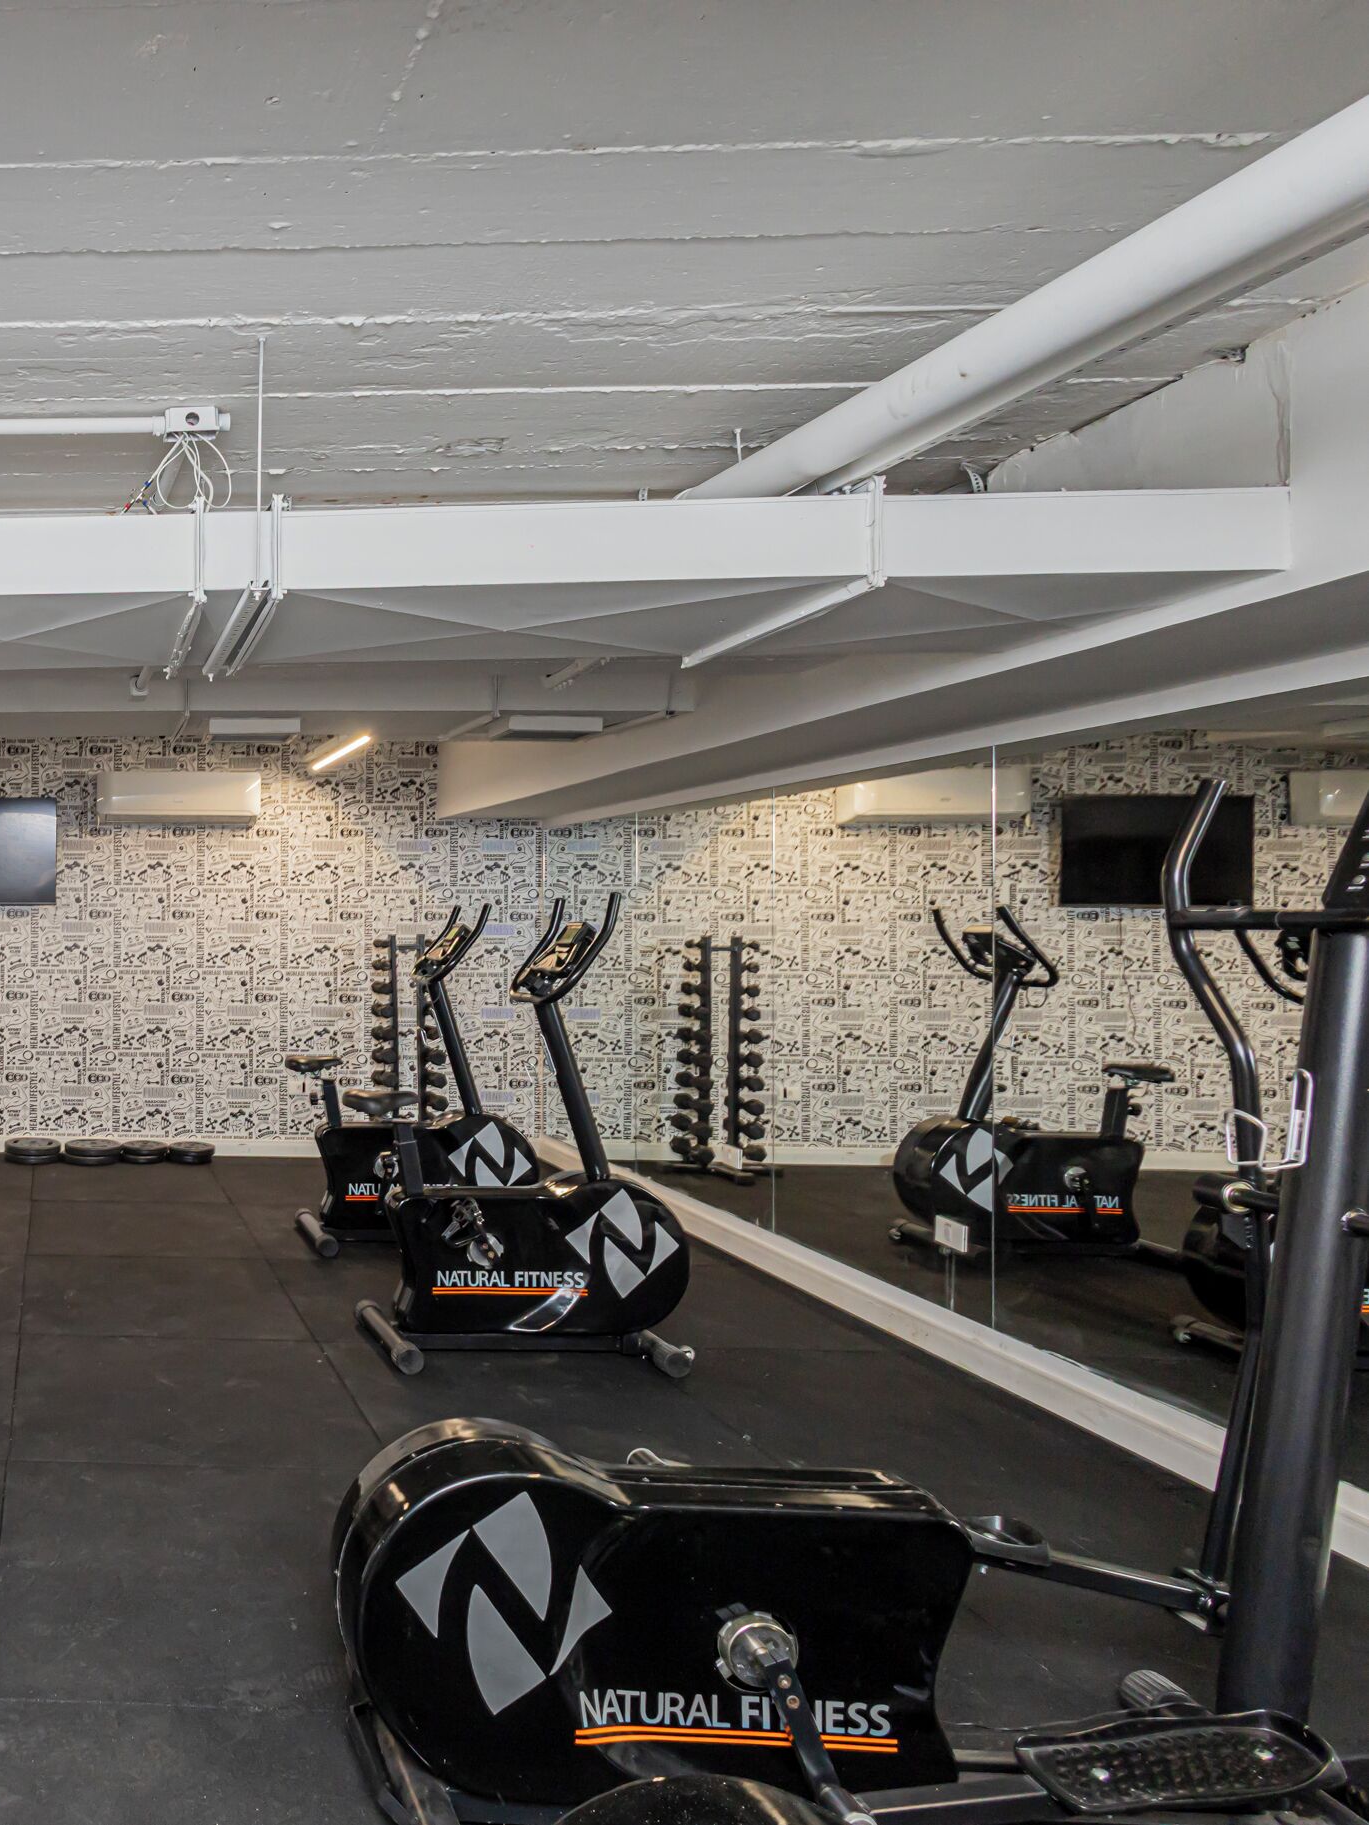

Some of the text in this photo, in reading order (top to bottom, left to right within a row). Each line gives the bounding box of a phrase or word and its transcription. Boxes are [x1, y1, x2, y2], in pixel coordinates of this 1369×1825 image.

[364, 744, 373, 803] HEALTHY LIFESTYLE
[113, 826, 122, 885] HEALTHY LIFESTYLE
[364, 827, 373, 886] HEALTHY LIFESTYLE
[449, 827, 458, 886] HEALTHY LIFESTYLE
[30, 908, 39, 967] HEALTHY LIFESTYLE
[113, 908, 122, 967] HEALTHY LIFESTYLE
[195, 909, 204, 968] HEALTHY LIFESTYLE
[279, 910, 288, 969] HEALTHY LIFESTYLE
[29, 990, 38, 1049] HEALTHY LIFESTYLE
[112, 991, 121, 1050] HEALTHY LIFESTYLE
[28, 1072, 37, 1131] HEALTHY LIFESTYLE
[111, 1073, 120, 1132] HEALTHY LIFESTYLE
[195, 1074, 204, 1133] HEALTHY LIFESTYLE
[348, 1183, 399, 1196] NATU
[437, 1270, 585, 1288] NATURAL FITNESS
[579, 1688, 892, 1737] NATURAL FIESS
